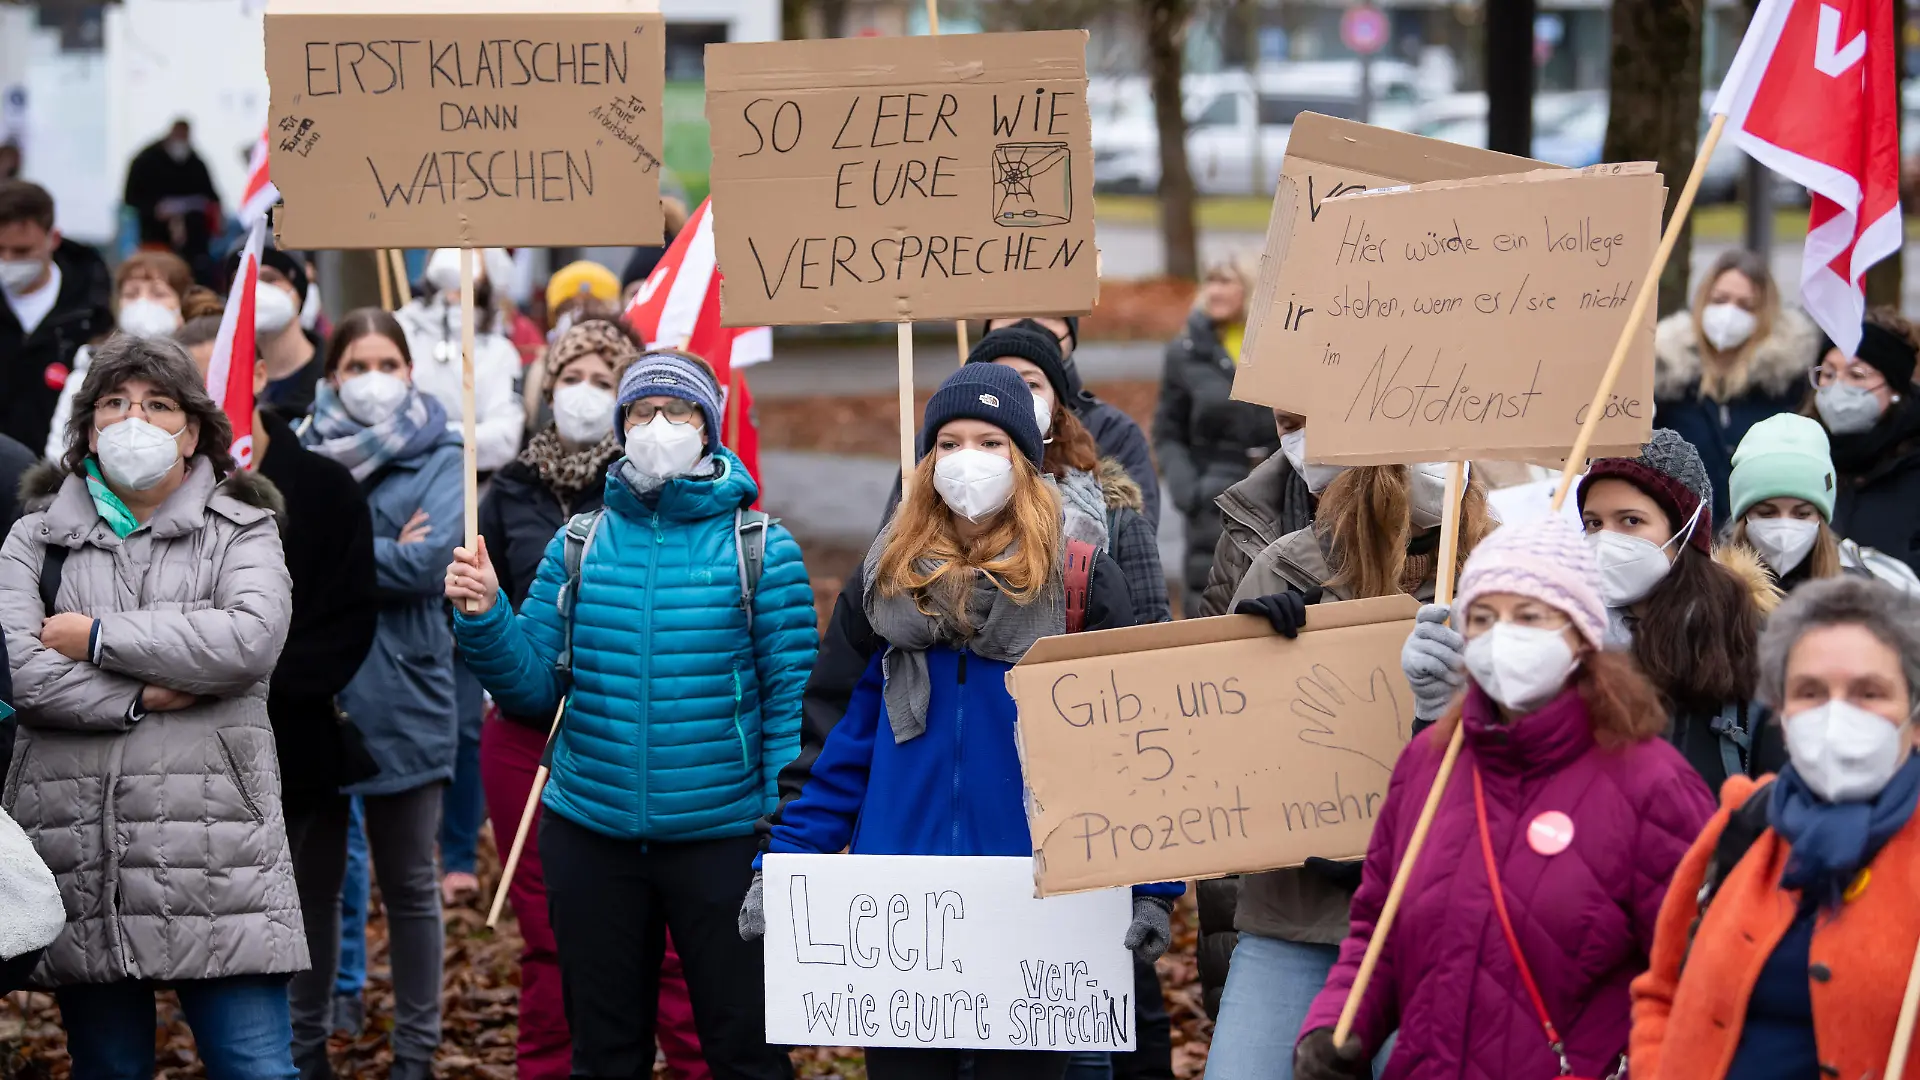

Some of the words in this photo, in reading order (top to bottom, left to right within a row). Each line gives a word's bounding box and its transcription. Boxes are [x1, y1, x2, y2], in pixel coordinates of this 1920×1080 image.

[440, 102, 517, 131] DANN
[739, 98, 802, 157] SO
[832, 93, 958, 149] LEER
[835, 156, 959, 209] EURE
[748, 232, 1084, 300] VERSPRECHEN
[1336, 214, 1387, 266] Hier
[1405, 218, 1480, 261] würde
[1493, 232, 1528, 253] ein
[1413, 297, 1464, 317] wenn
[1579, 280, 1633, 309] nicht
[1322, 342, 1341, 366] im
[1344, 345, 1543, 427] Notdienst
[1052, 669, 1142, 728] Gib
[1176, 676, 1248, 718] uns
[1135, 728, 1175, 782] 5
[1072, 785, 1251, 862] Prozent
[1282, 771, 1381, 832] mehr
[802, 983, 880, 1037] wie
[889, 989, 991, 1042] eure
